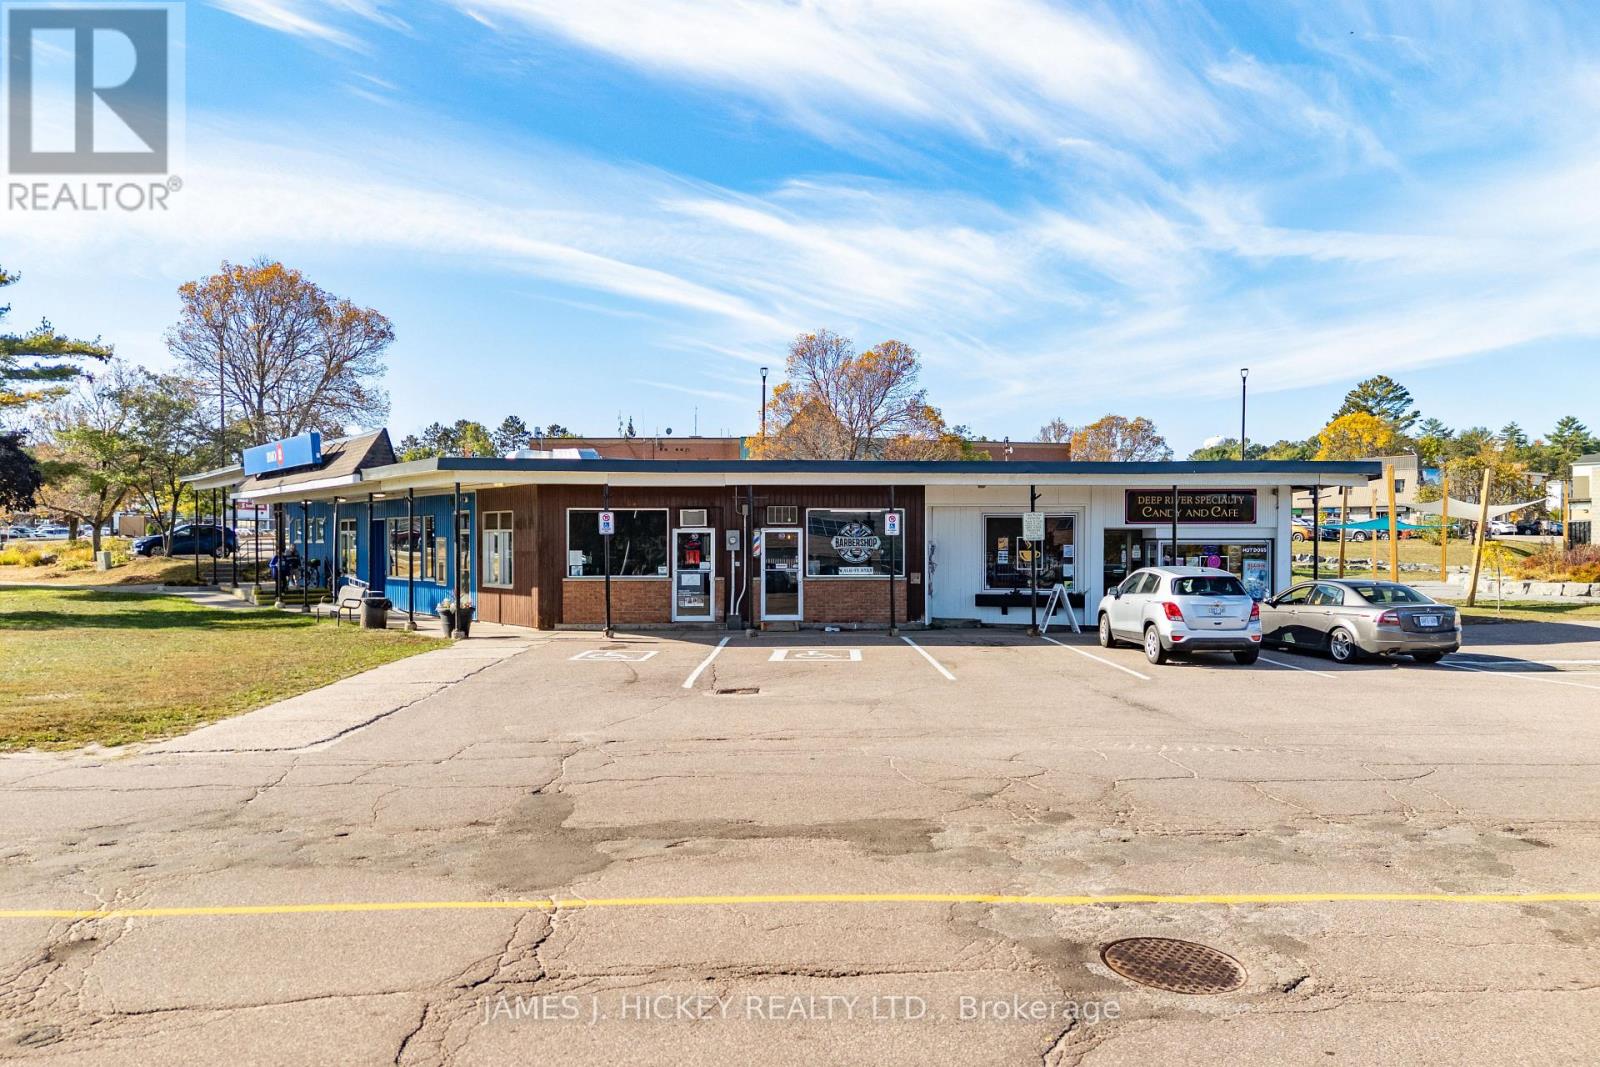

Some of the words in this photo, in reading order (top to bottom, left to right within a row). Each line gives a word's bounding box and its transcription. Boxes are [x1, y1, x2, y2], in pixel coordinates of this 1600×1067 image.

[1138, 495, 1163, 505] DEEP
[1194, 495, 1245, 505] SPECIALTY
[1185, 508, 1209, 518] AND
[1210, 505, 1239, 518] CAFE
[835, 537, 878, 548] BARBERSHOP
